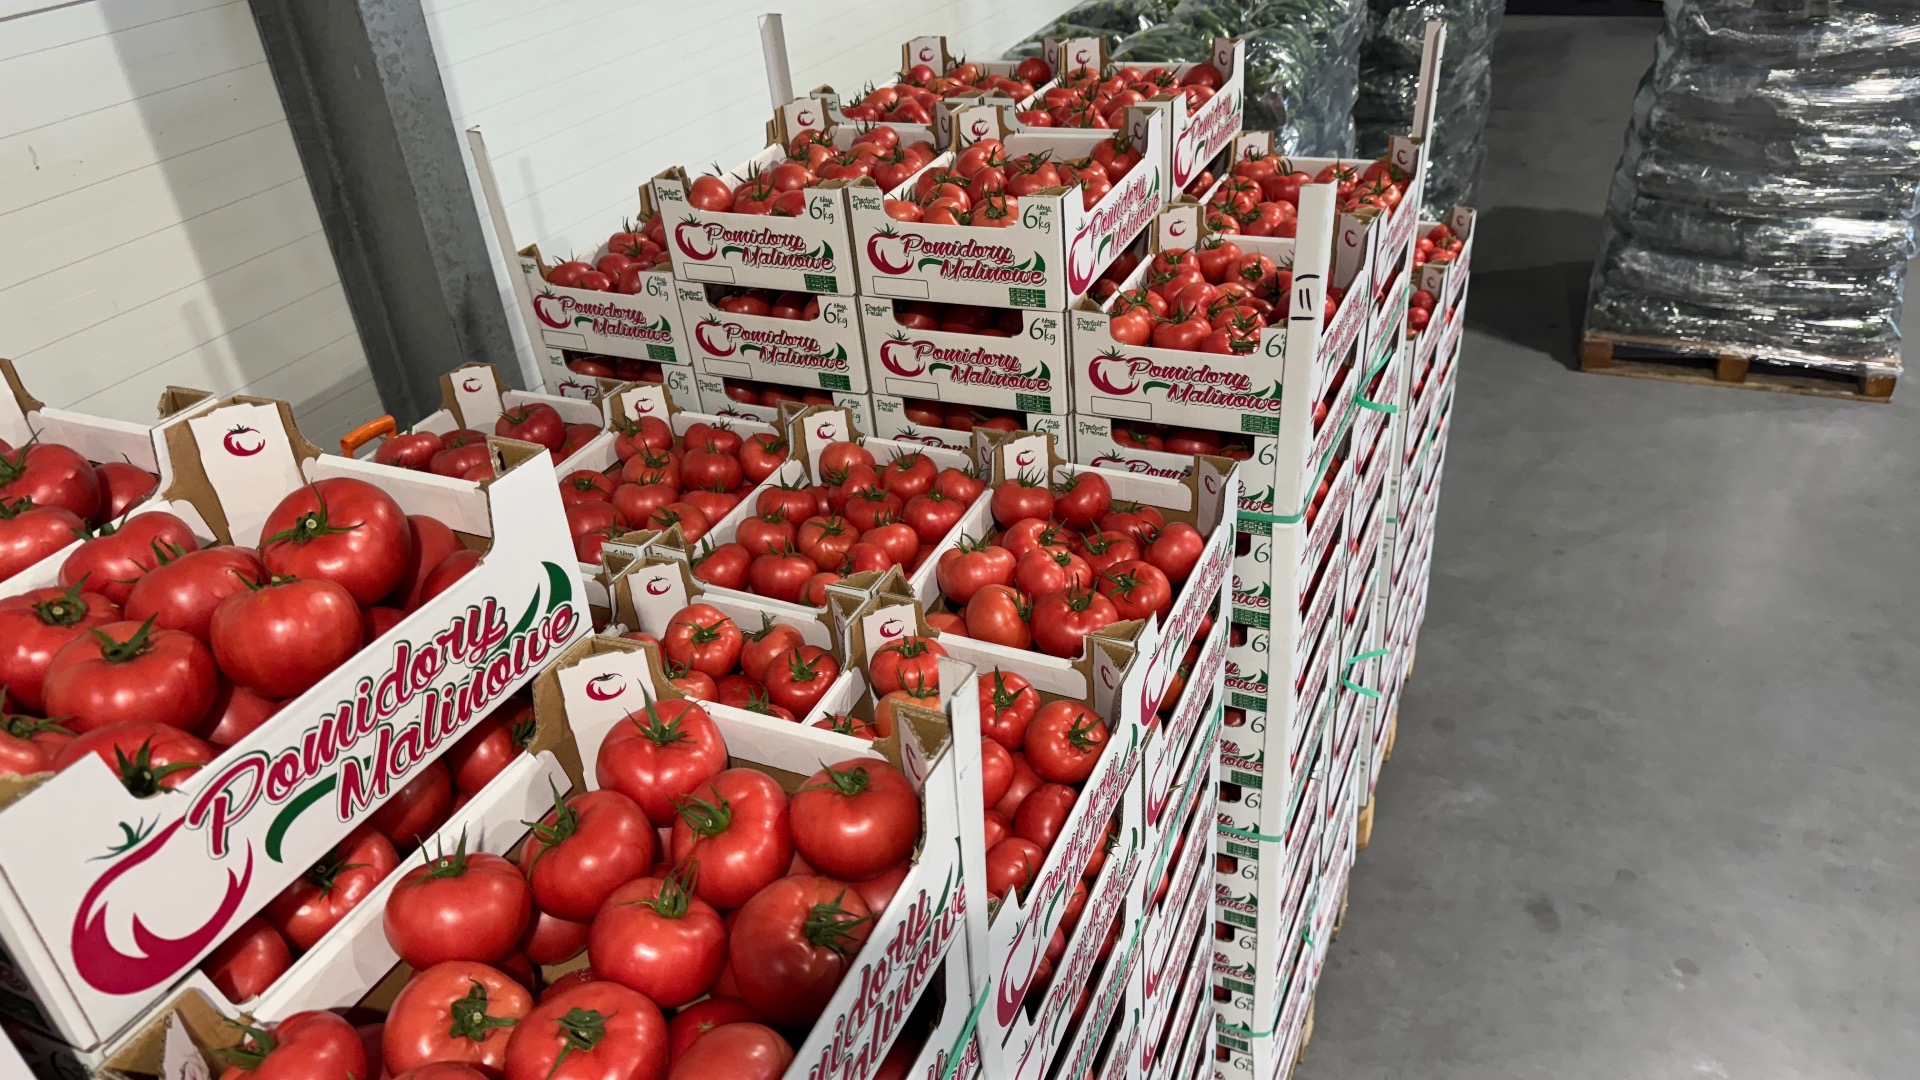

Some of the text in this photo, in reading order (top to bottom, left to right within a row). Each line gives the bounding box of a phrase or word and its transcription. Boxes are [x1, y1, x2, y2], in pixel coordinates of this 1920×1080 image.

[809, 196, 822, 219] 6
[823, 207, 834, 224] kg
[1023, 205, 1038, 229] 6
[1039, 216, 1051, 234] kg
[703, 222, 806, 251] Pomidory
[900, 233, 1015, 264] Pomidory
[741, 247, 836, 272] Malinowe
[940, 259, 1047, 286] Malinowe
[646, 276, 658, 296] 6
[659, 286, 669, 301] kg
[558, 296, 646, 324] Pomidory
[824, 303, 836, 323] 6
[837, 312, 848, 328] kg
[592, 318, 673, 343] Malinowe
[722, 322, 820, 352] Pomidory
[1029, 318, 1043, 340] 6
[1044, 329, 1055, 345] kg
[1265, 334, 1281, 357] 6
[759, 345, 849, 372] Malinowe
[913, 341, 1021, 372] Pomidory
[668, 371, 678, 389] 6
[951, 365, 1052, 393] Malinowe
[1125, 357, 1252, 390] Pomidory
[680, 381, 689, 394] kg
[1167, 383, 1281, 414] Malinowe
[1258, 444, 1274, 465] 6
[1254, 543, 1269, 562] 6
[1251, 634, 1266, 652] 6
[337, 602, 579, 822] Malinowe
[184, 597, 508, 860] Pomidory
[1250, 716, 1265, 733] 6
[1245, 793, 1258, 808] 6
[1241, 865, 1254, 879] 6
[1239, 935, 1252, 949] 6
[1234, 996, 1247, 1009] 6
[1233, 1057, 1246, 1070] 6
